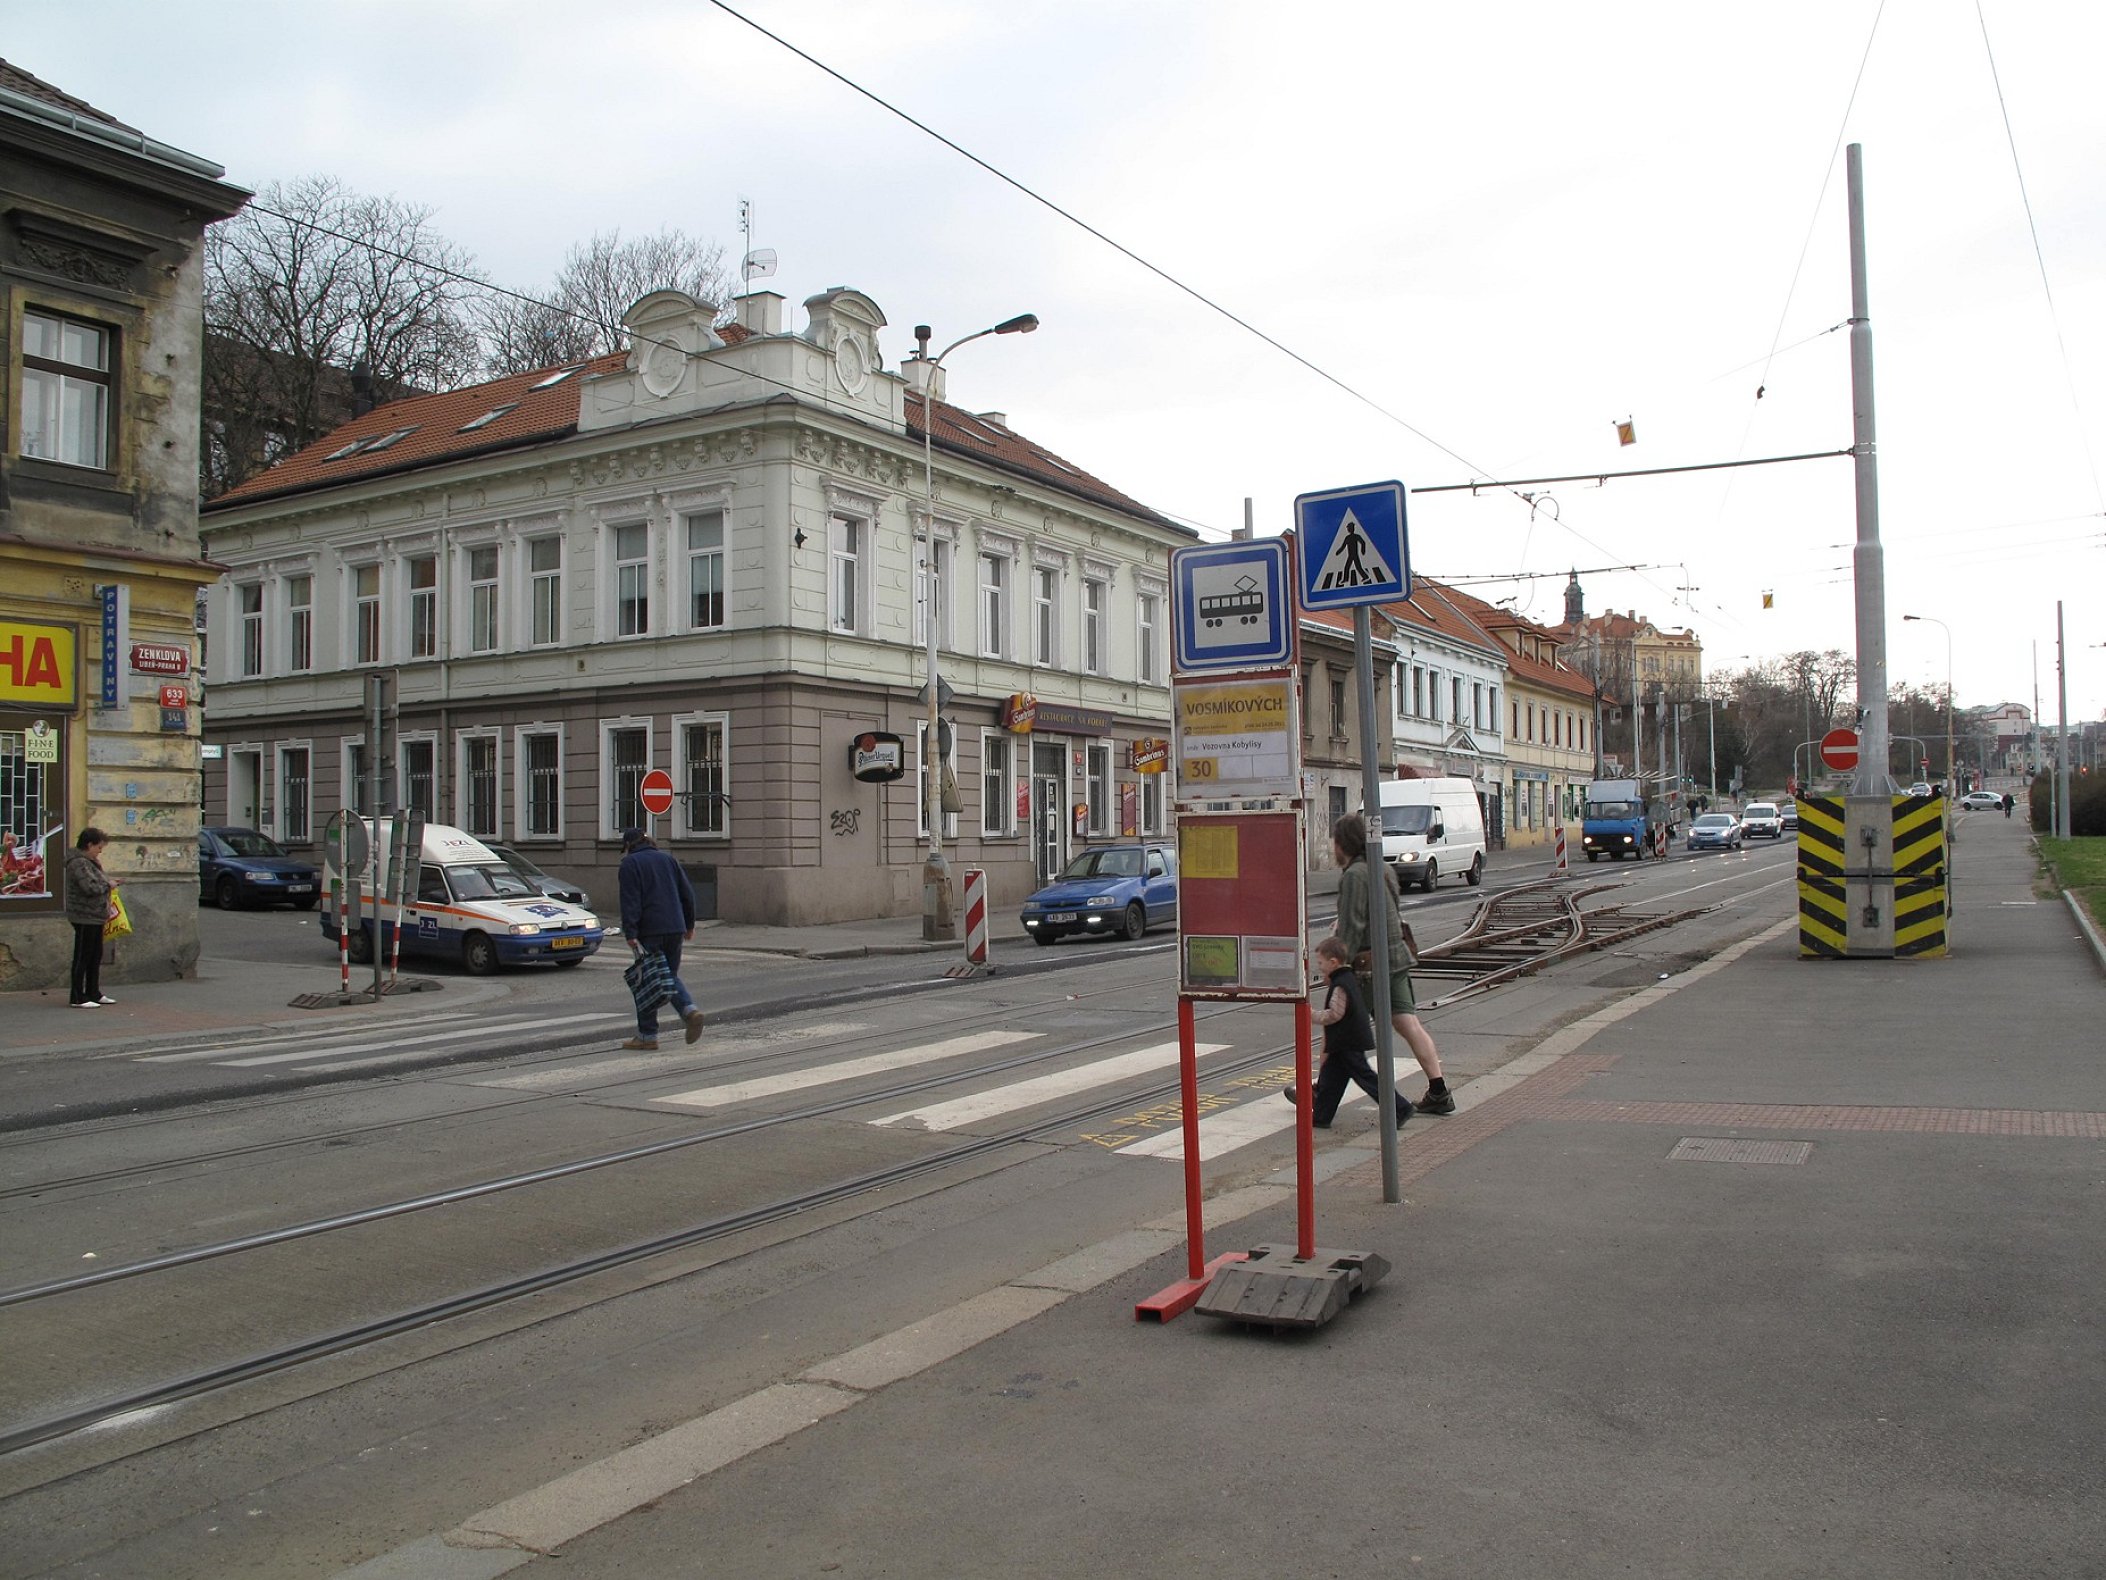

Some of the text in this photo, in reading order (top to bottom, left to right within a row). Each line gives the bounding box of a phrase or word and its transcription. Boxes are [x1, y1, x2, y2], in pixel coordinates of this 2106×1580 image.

[106, 591, 116, 699] POTRAVINY
[138, 648, 181, 662] ZENKLOVA
[166, 689, 183, 698] 633
[1186, 696, 1282, 716] VOSMÍKOVÝCH
[1202, 743, 1230, 751] Vozovna
[1232, 740, 1262, 750] Kobylisy
[28, 750, 54, 759] FOOD
[1135, 749, 1165, 766] Gambrinus
[1191, 760, 1211, 778] 30
